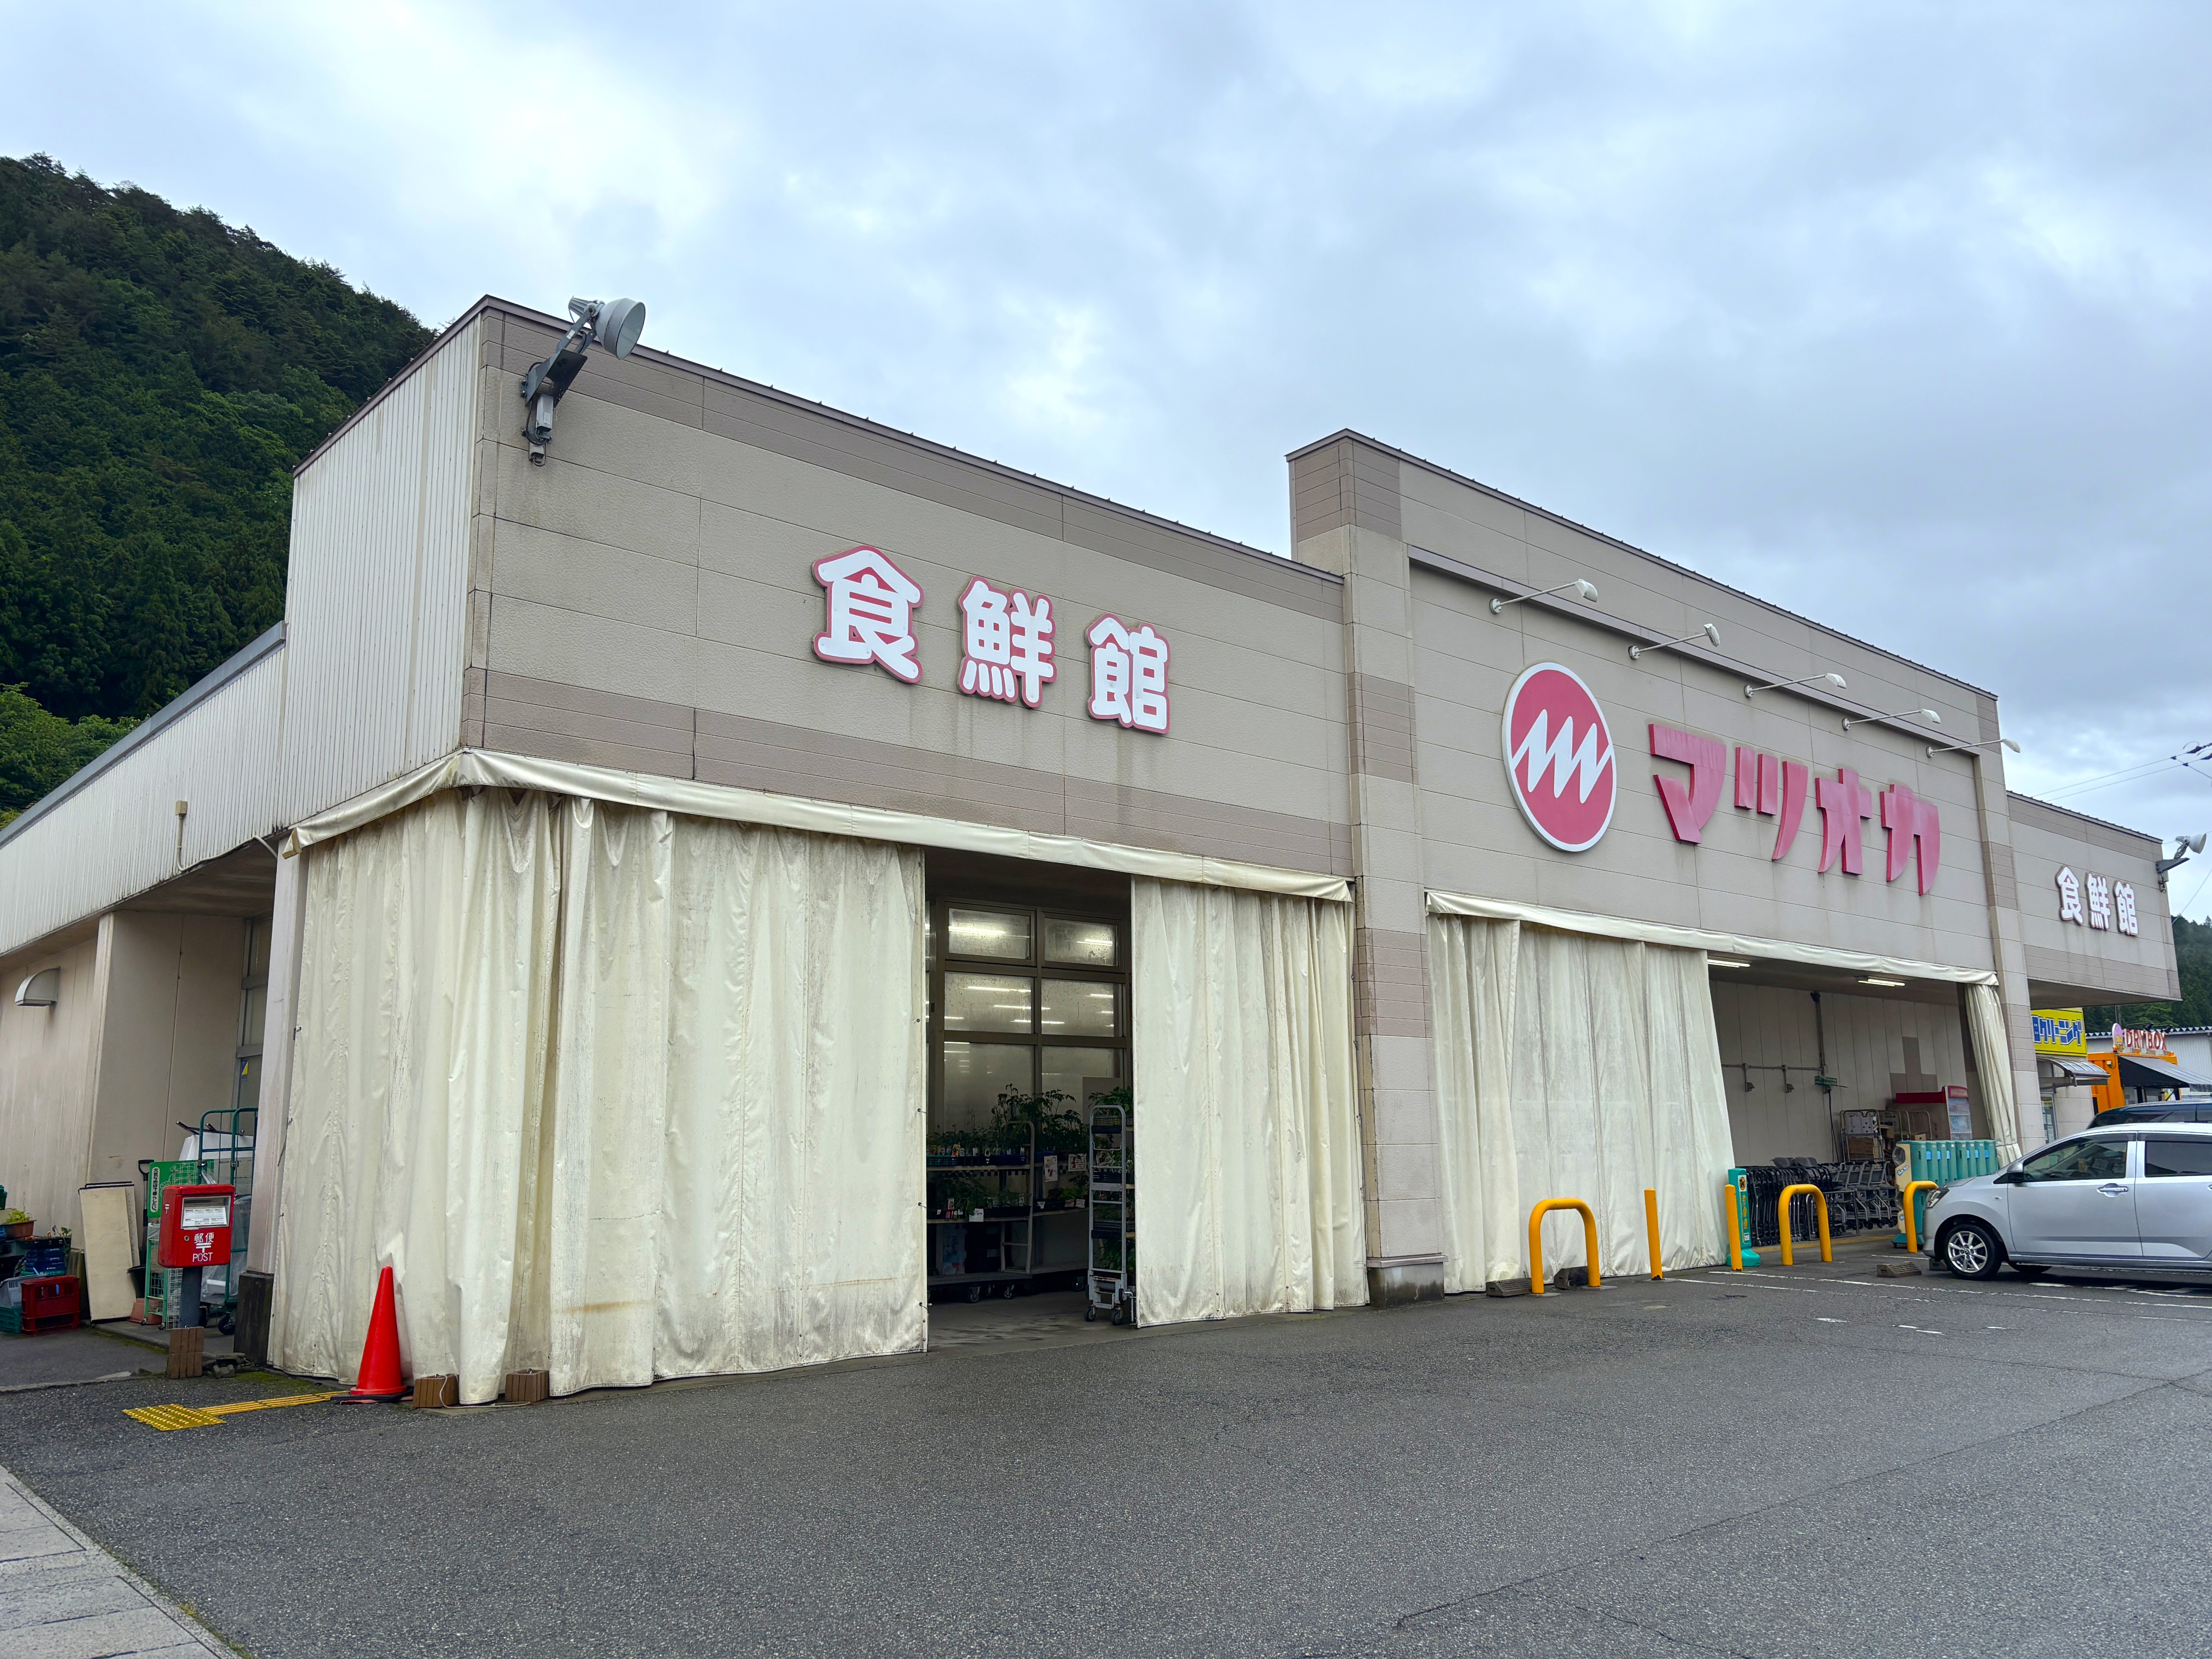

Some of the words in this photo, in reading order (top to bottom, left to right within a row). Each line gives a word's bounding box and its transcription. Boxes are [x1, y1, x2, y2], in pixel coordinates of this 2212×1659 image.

[812, 545, 1170, 734] 食鮮館
[1649, 724, 1940, 896] マツオカ
[2055, 866, 2138, 936] 食鮮館
[2124, 1029, 2145, 1049] DRY
[2146, 1031, 2166, 1050] BOX
[193, 1253, 213, 1262] POST
[194, 1232, 214, 1243] 郵便
